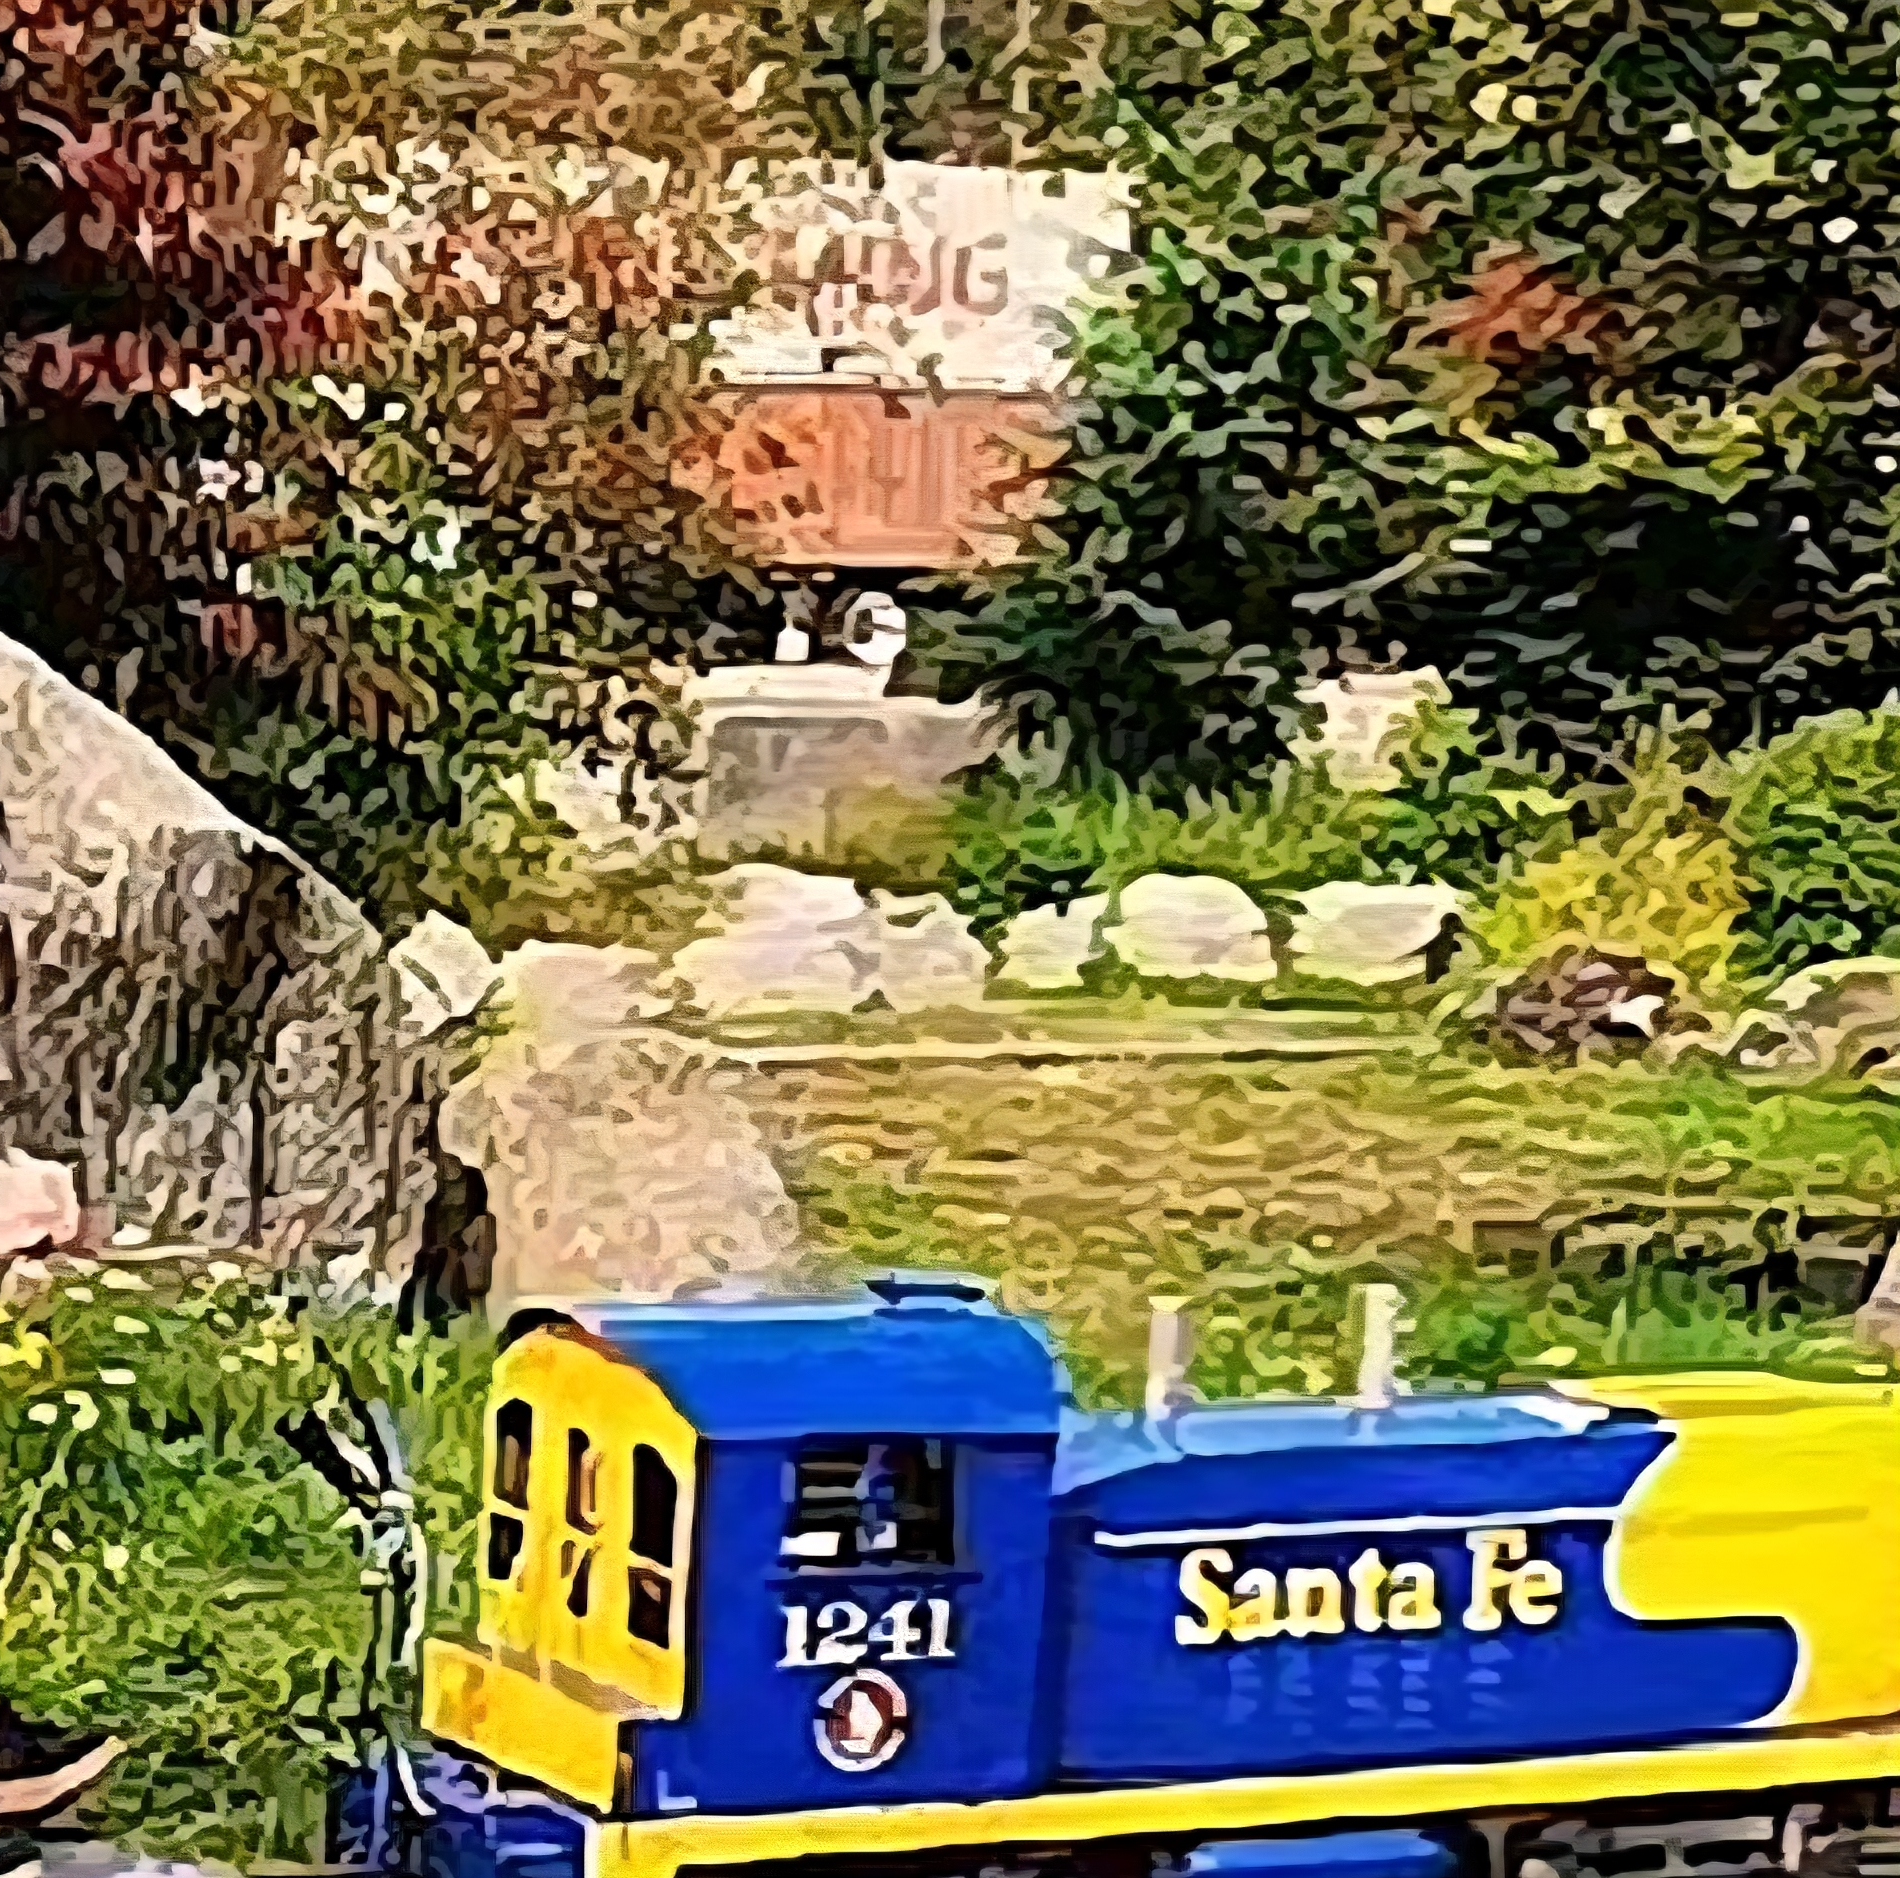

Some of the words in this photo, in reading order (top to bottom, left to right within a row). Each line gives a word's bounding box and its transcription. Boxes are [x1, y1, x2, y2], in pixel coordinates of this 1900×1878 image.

[776, 1597, 956, 1671] 1241
[1175, 1546, 1442, 1645] Santa
[1461, 1528, 1563, 1632] Fe
